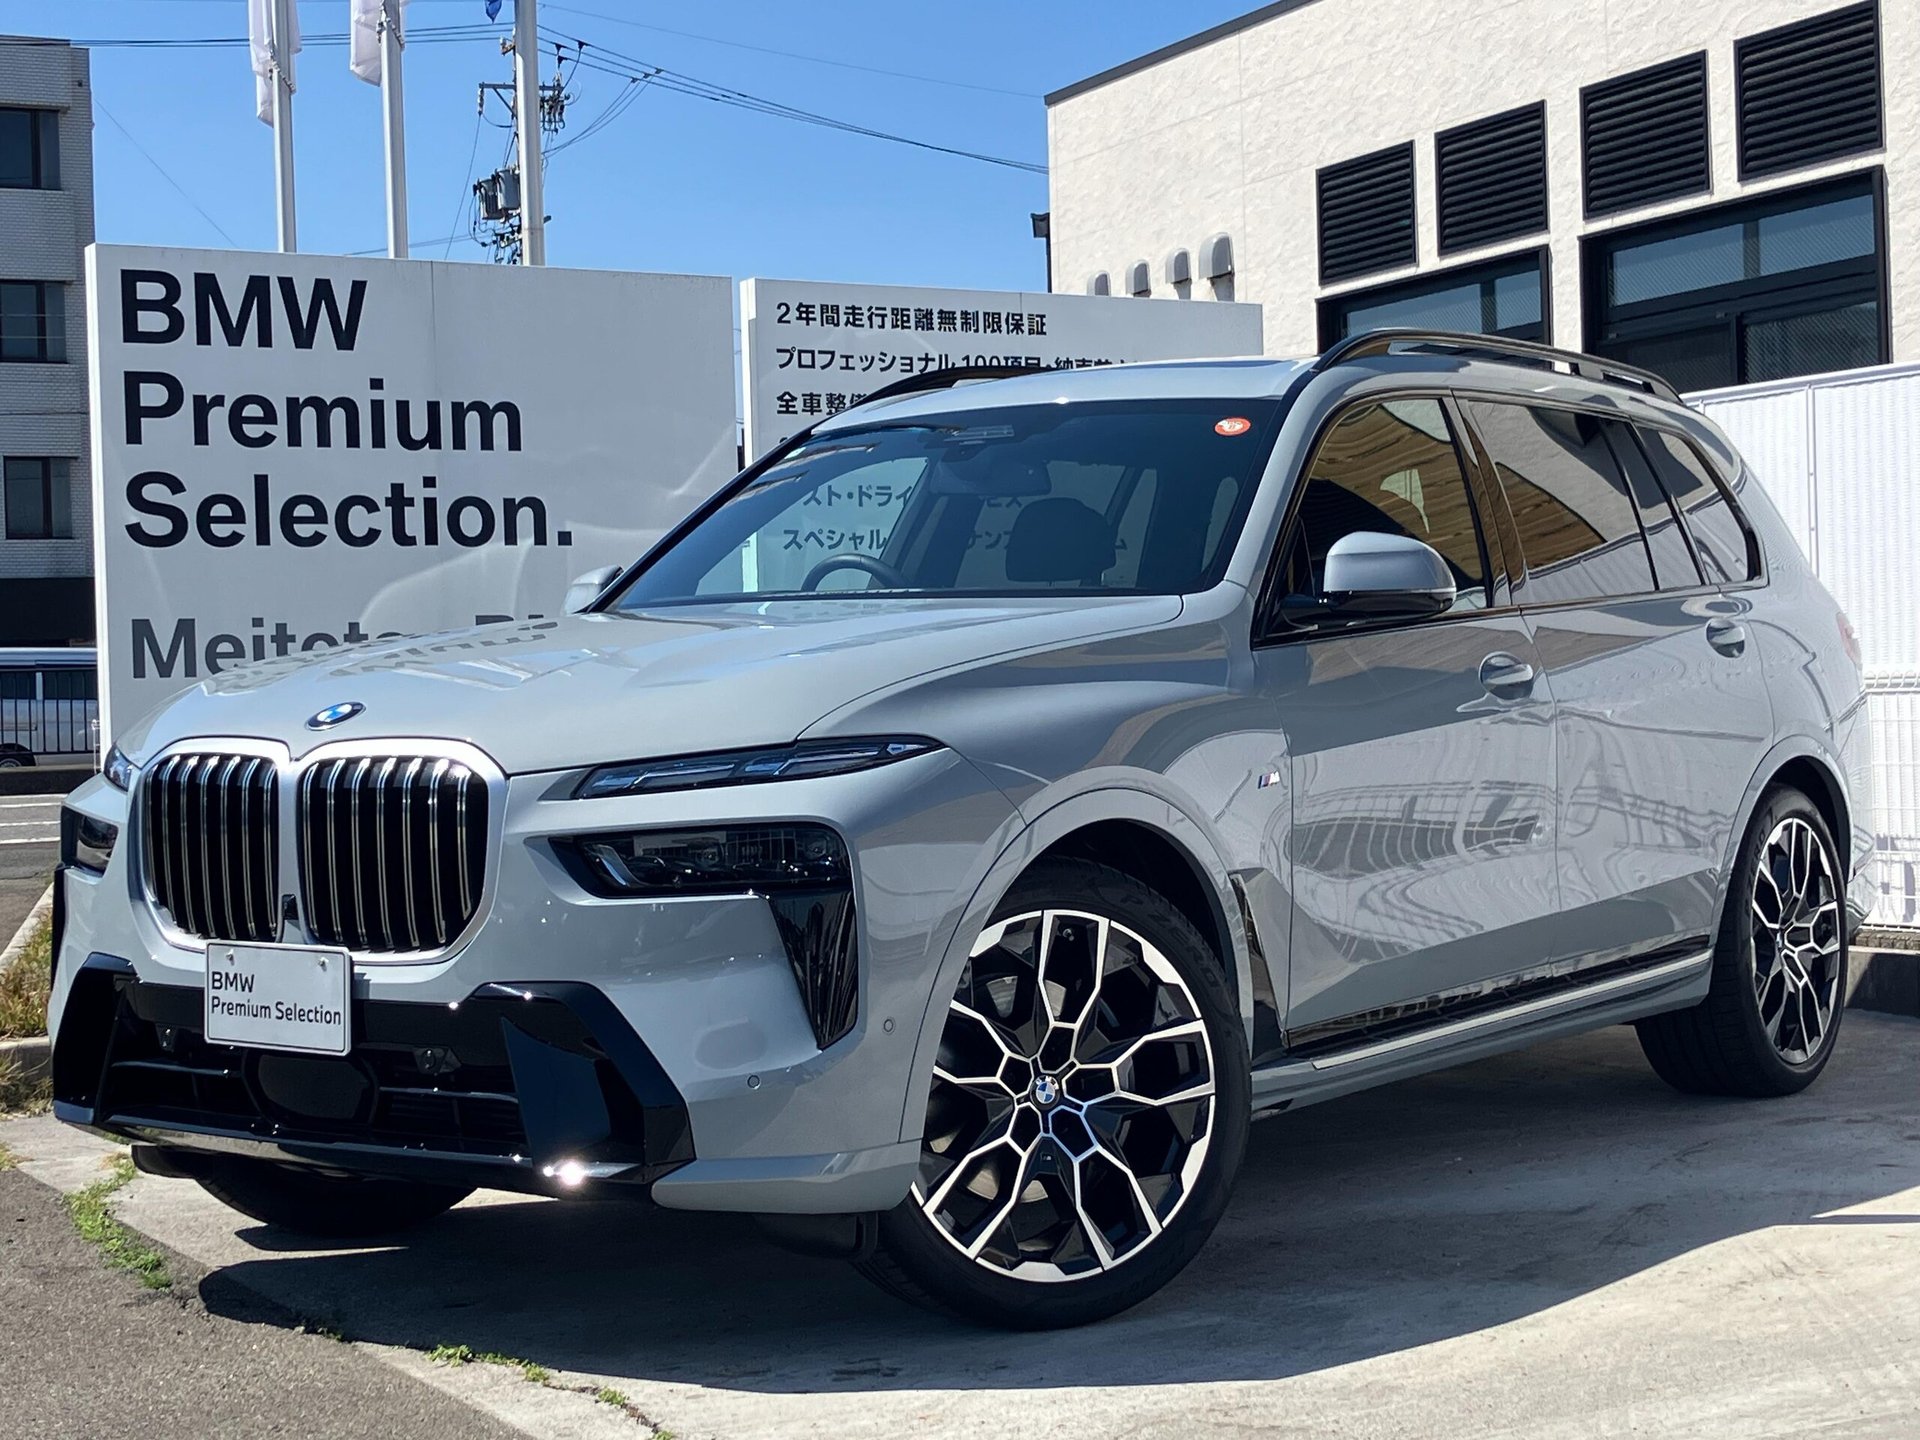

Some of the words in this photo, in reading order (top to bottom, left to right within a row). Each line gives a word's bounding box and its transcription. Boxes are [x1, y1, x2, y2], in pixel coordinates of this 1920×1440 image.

[121, 269, 367, 351] BMW
[776, 302, 1047, 336] 2年間走行距離無制限保証
[124, 371, 522, 451] Premium
[125, 471, 573, 548] Selection.
[212, 971, 255, 992] BMW
[212, 996, 272, 1019] Premium
[275, 1001, 341, 1025] Selection
